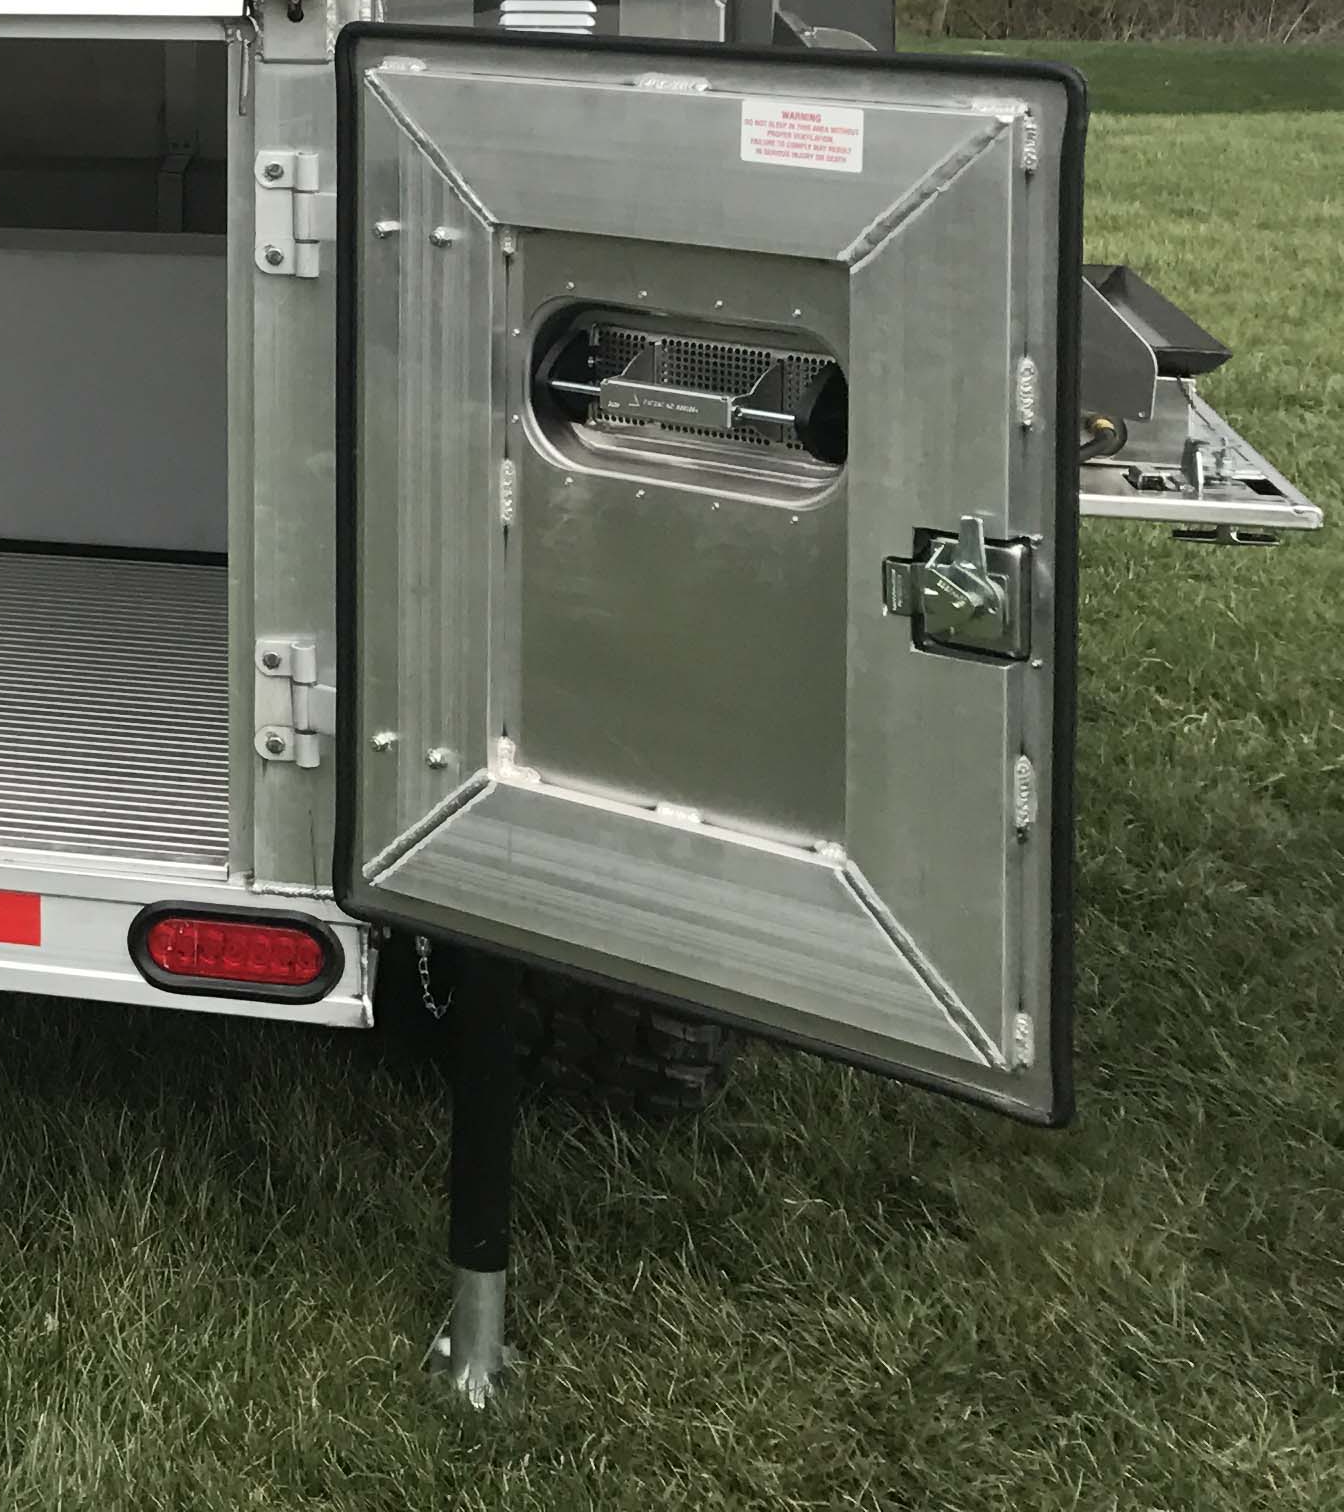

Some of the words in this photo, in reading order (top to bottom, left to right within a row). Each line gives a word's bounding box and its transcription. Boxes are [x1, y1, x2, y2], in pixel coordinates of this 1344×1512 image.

[782, 112, 821, 123] WARNING
[831, 126, 858, 135] WITHOUT
[787, 141, 811, 149] COMPLY
